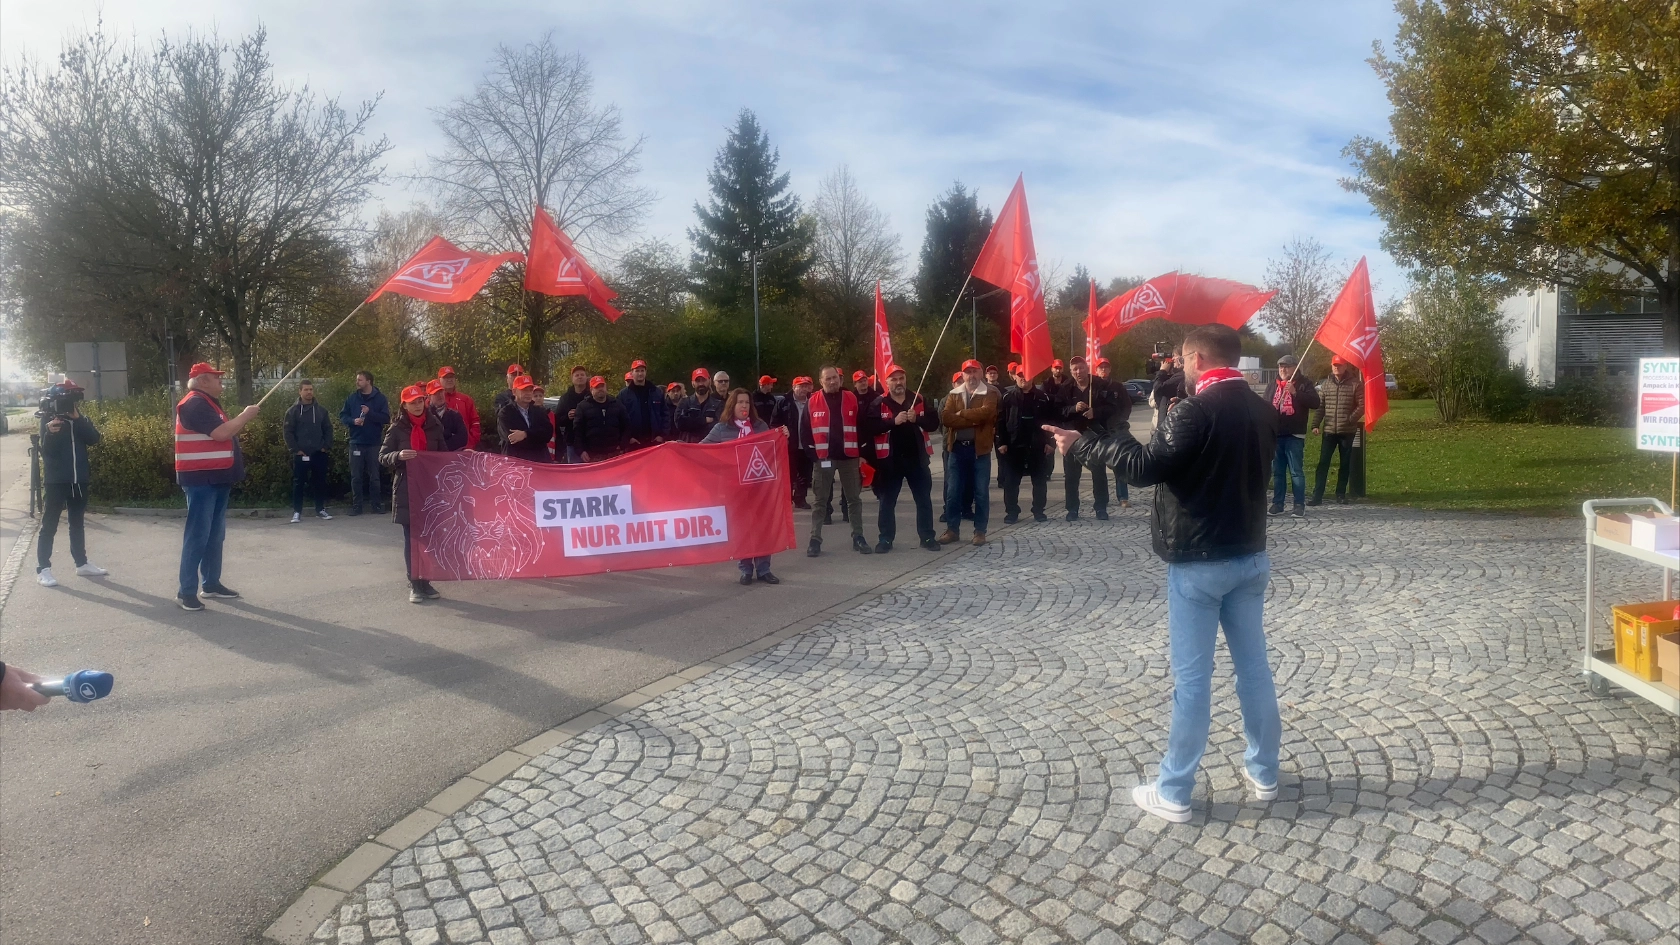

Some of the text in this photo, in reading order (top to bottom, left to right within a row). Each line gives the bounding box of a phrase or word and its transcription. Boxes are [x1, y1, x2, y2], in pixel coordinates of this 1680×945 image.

[1643, 362, 1680, 373] SYNT
[542, 493, 626, 520] STARK.
[571, 515, 722, 549] NUR MIT DIR.
